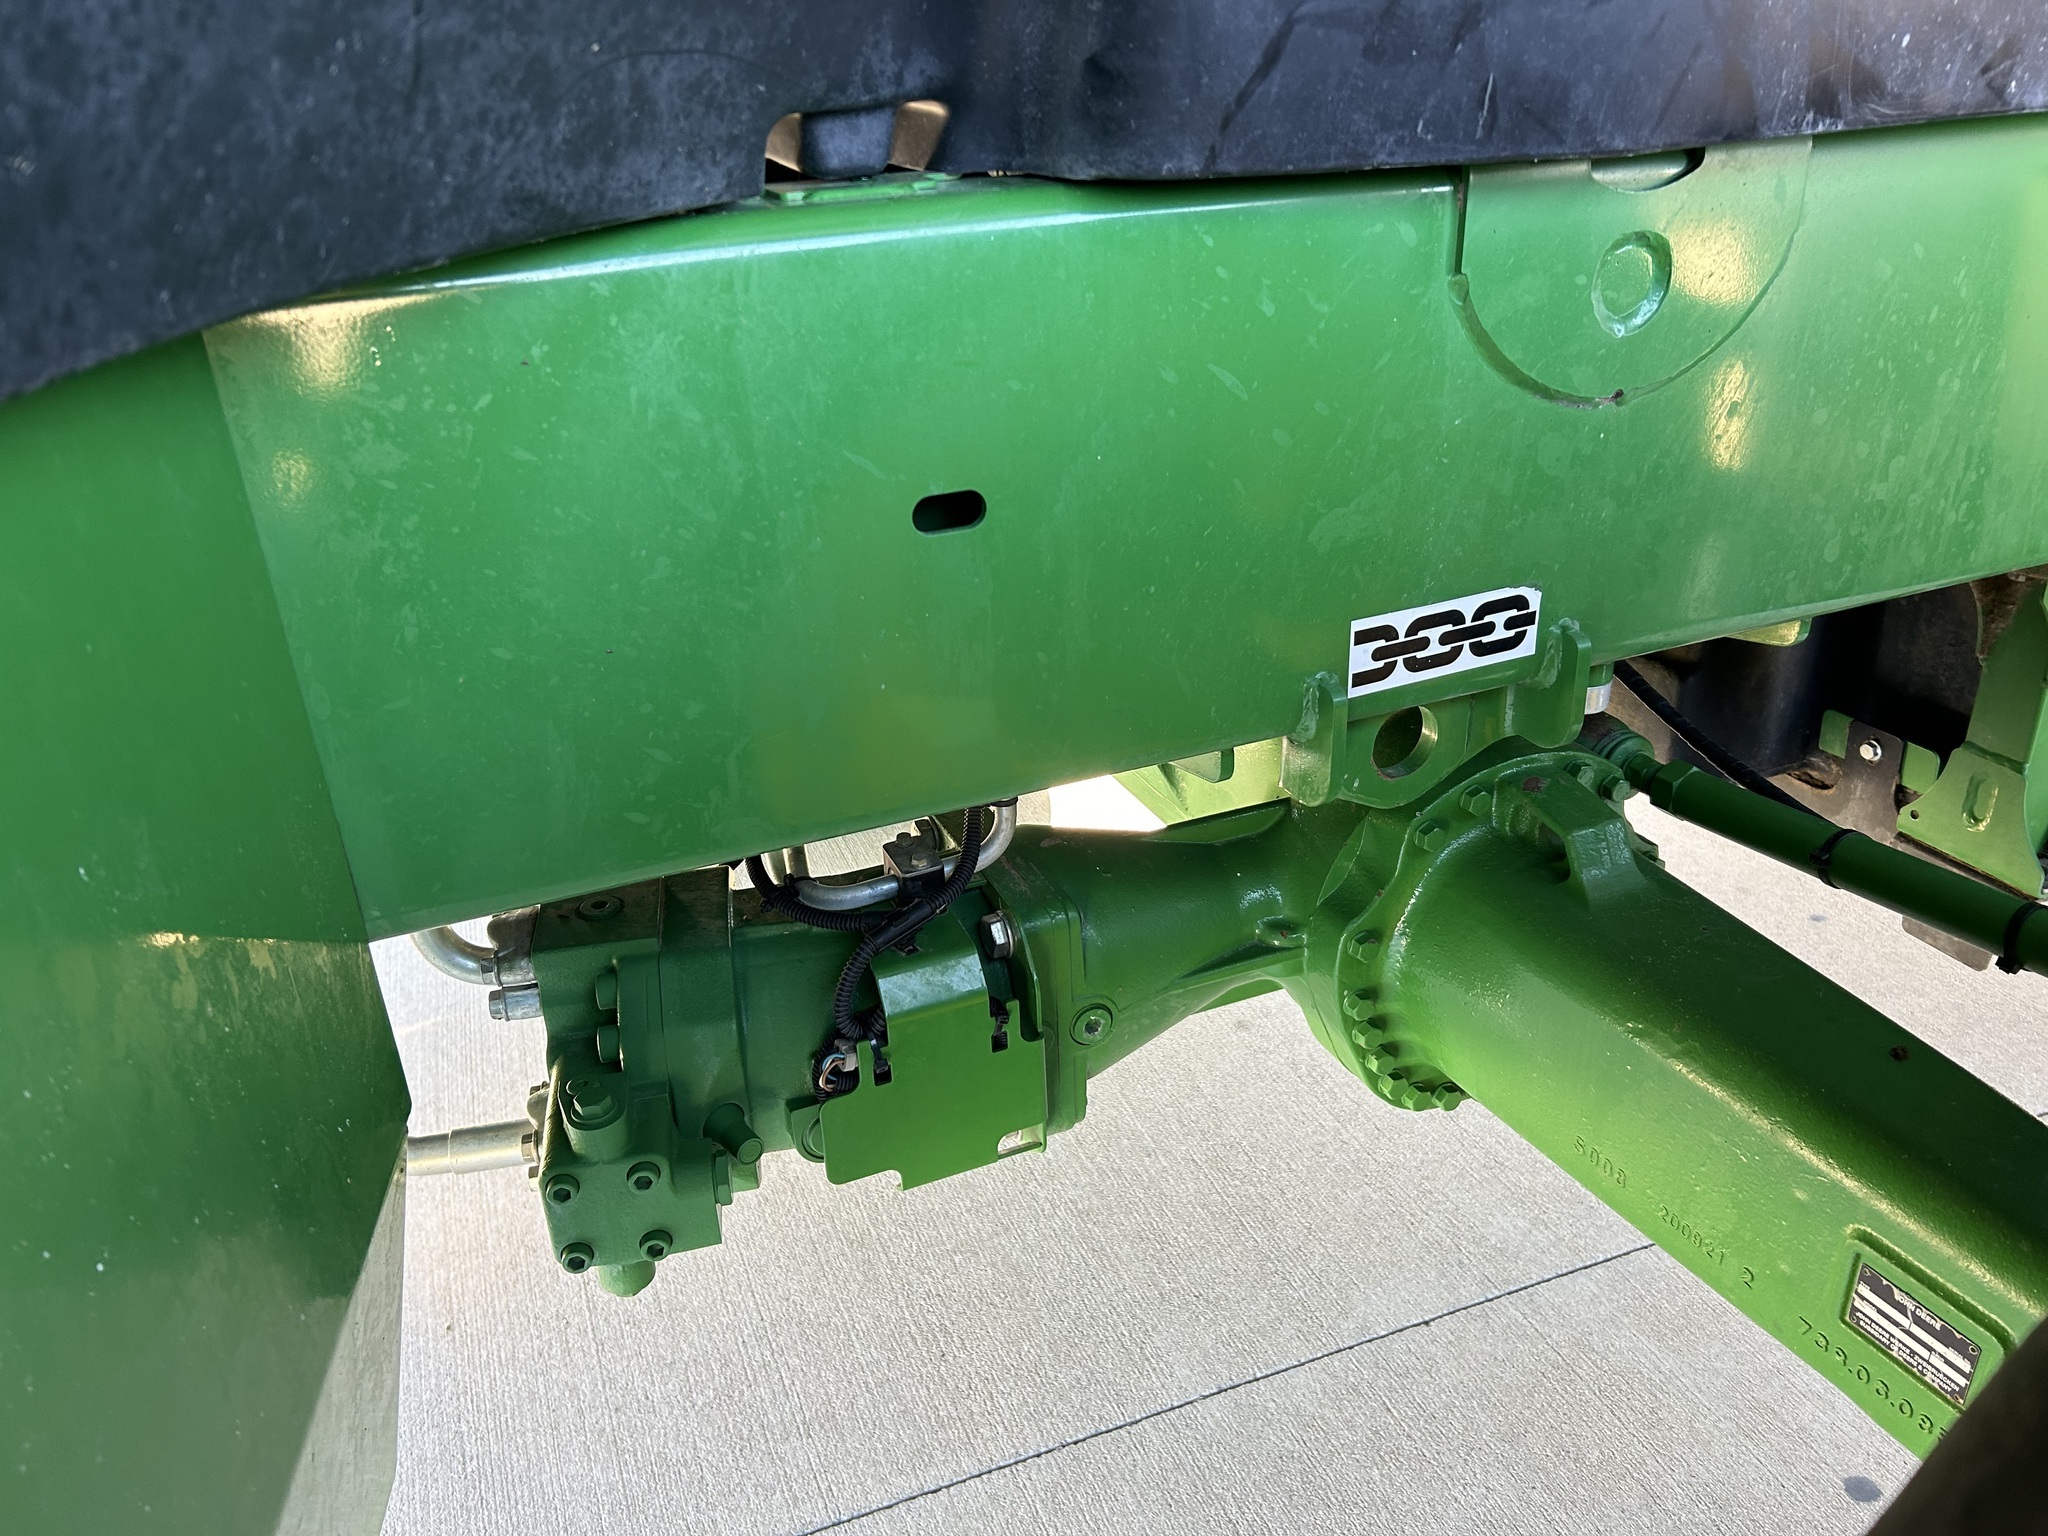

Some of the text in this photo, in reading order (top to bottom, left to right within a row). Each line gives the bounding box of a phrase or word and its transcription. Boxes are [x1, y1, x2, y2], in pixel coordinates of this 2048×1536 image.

[1915, 1307, 1942, 1331] DEERE
[1855, 1310, 1960, 1392] JOHN DEERE WERKE ZWEIBRUECKEN
[1898, 1349, 1918, 1367] DEERE
[1922, 1367, 1952, 1392] COMPANY
